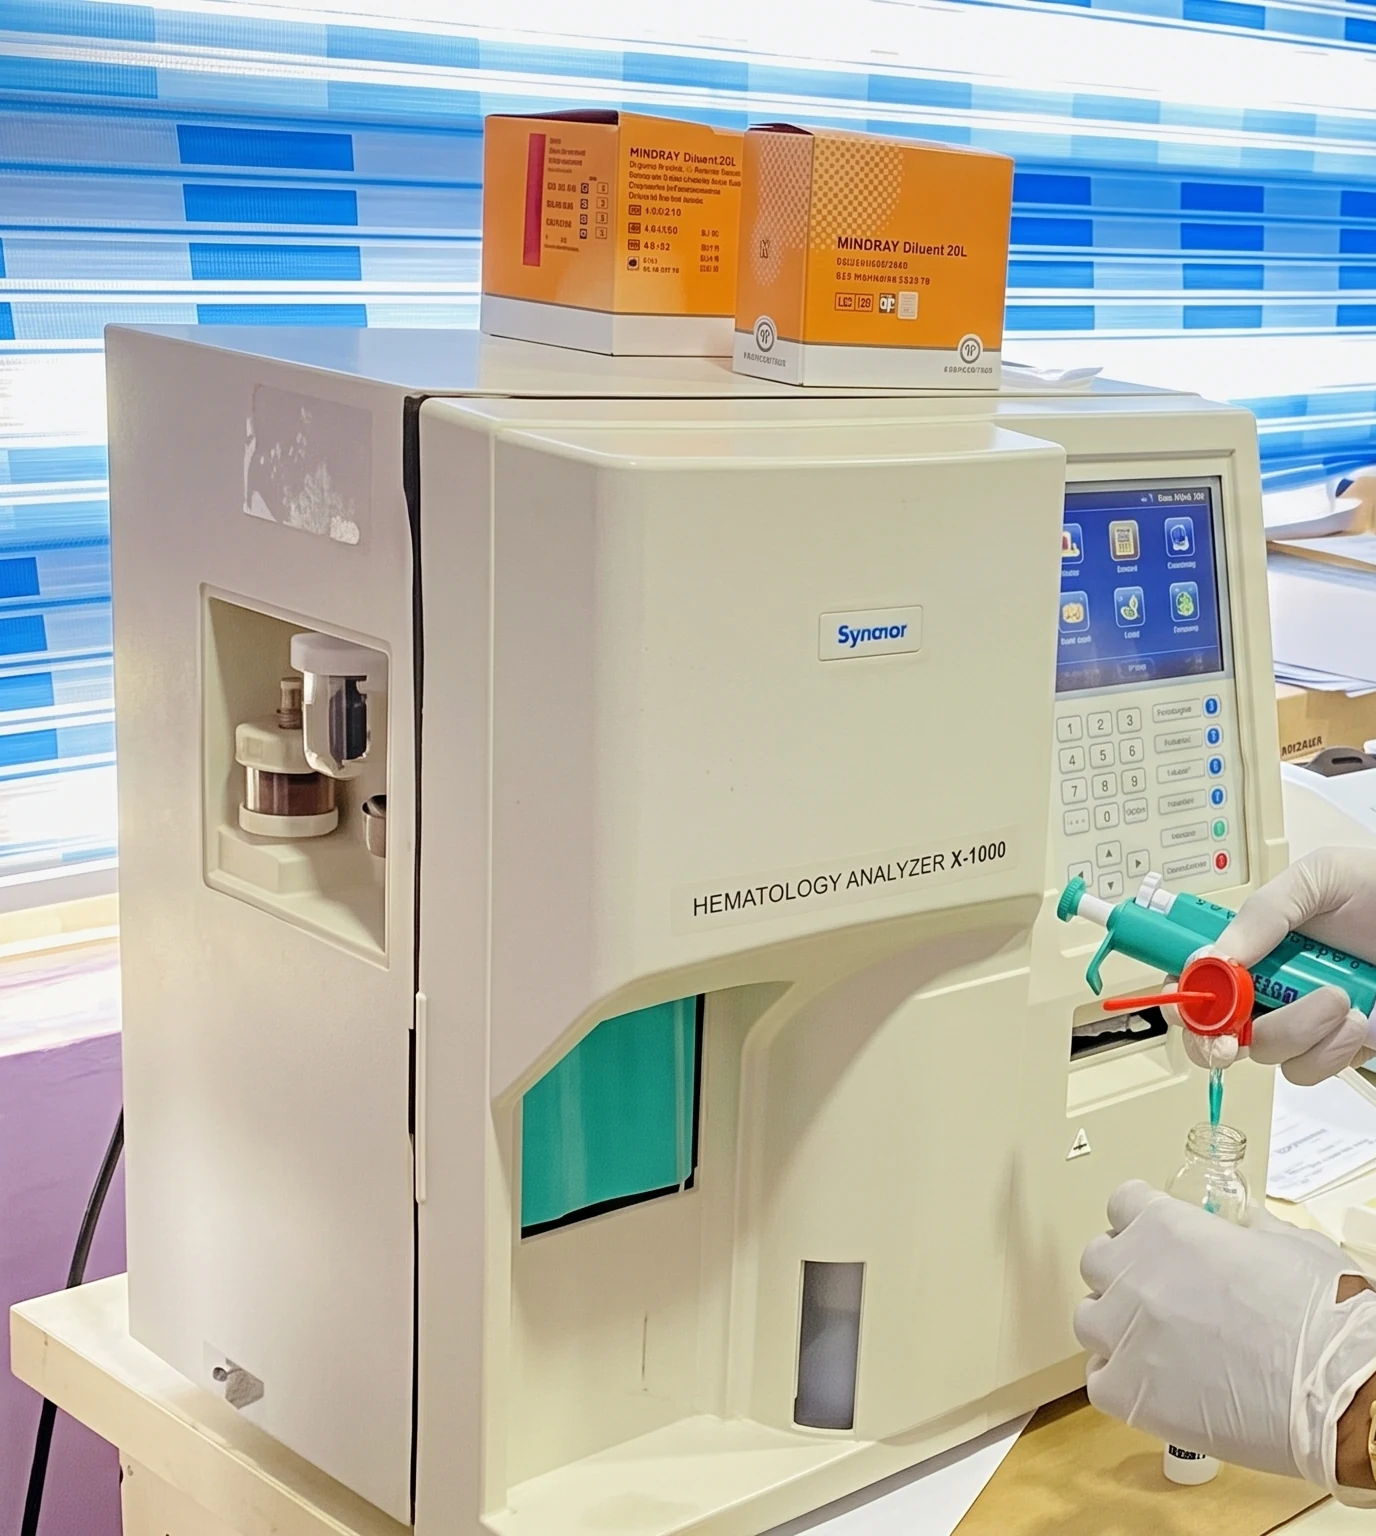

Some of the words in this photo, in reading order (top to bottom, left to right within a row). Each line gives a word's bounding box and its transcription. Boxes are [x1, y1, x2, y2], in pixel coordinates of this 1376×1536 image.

[629, 147, 680, 161] MINDRAY
[837, 236, 900, 252] MINDRAY
[903, 241, 945, 256] Diluent
[946, 245, 968, 257] 20L
[1067, 723, 1072, 734] 1
[1097, 719, 1104, 730] 2
[1126, 715, 1133, 726] 3
[1068, 754, 1076, 765] 4
[1100, 750, 1106, 761] 5
[1129, 745, 1135, 756] 6
[1071, 785, 1077, 797] 7
[1101, 780, 1108, 792] 8
[1131, 776, 1138, 787] 9
[1103, 811, 1110, 822] 0
[693, 873, 842, 917] HEMATOLOGY
[846, 853, 945, 889] ANALYZER
[950, 841, 1006, 869] X-1000
